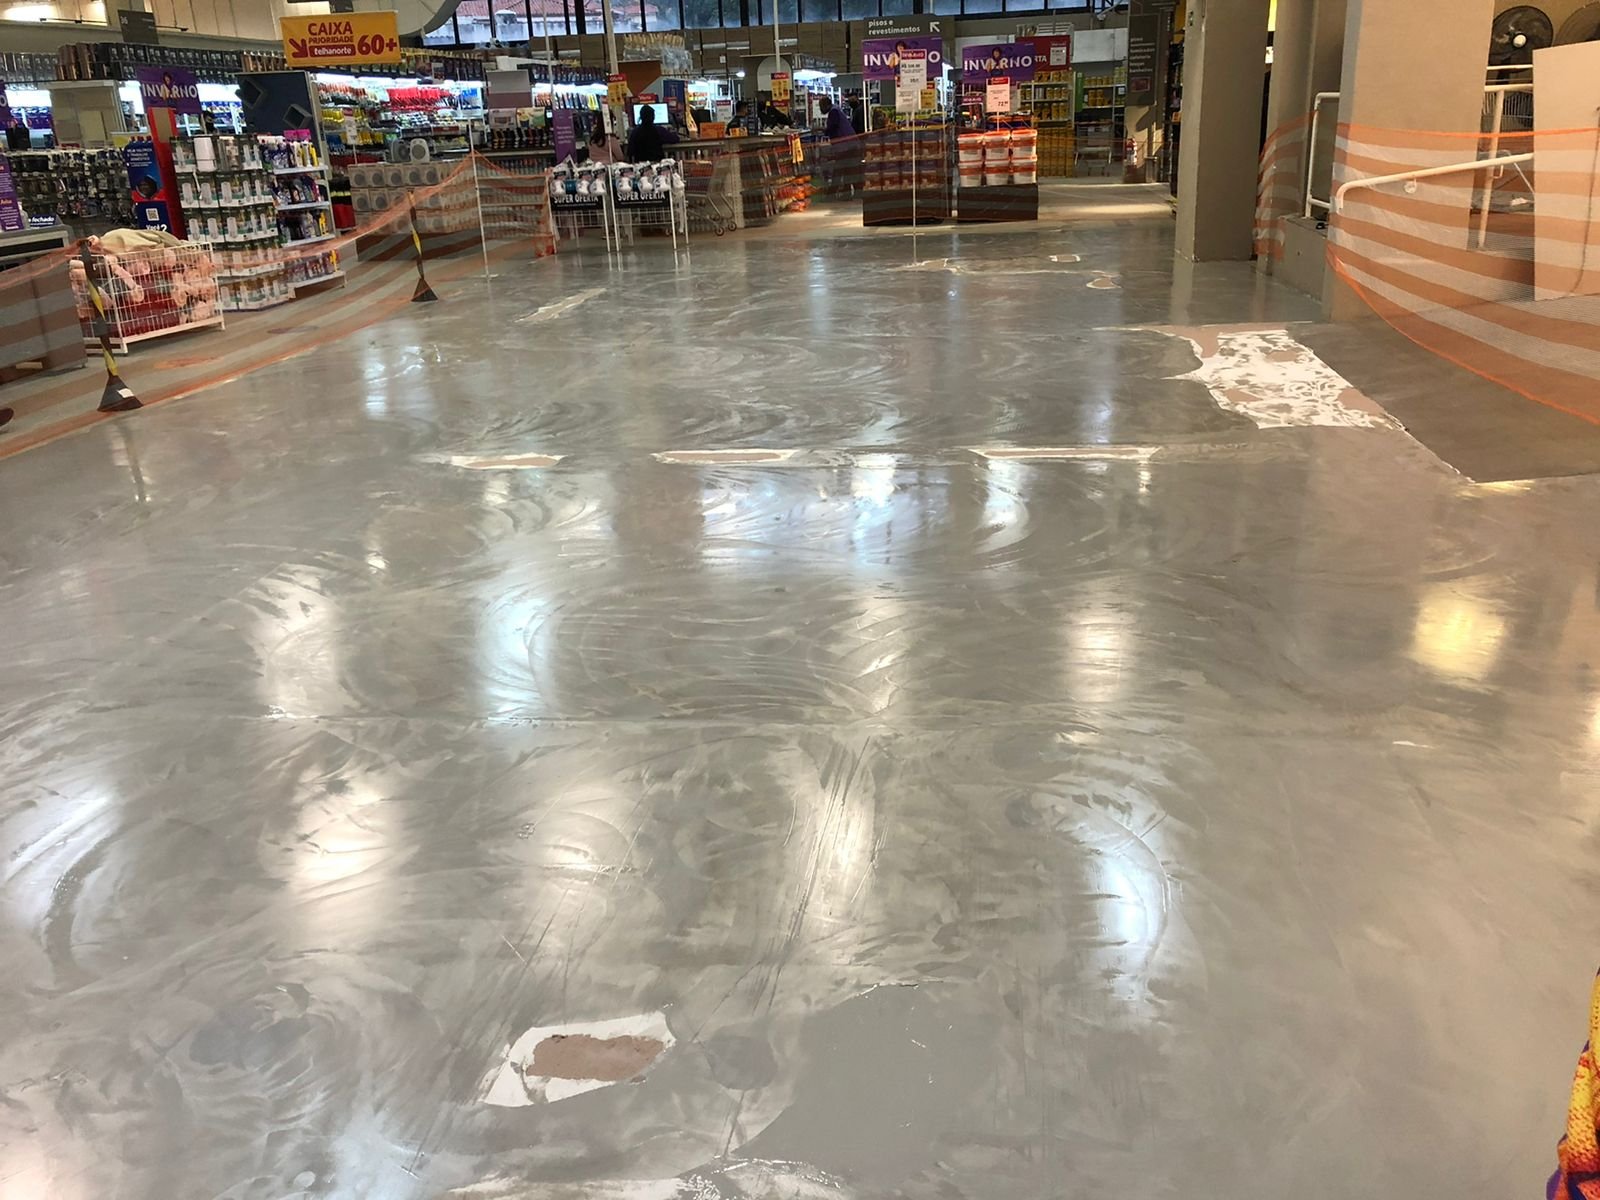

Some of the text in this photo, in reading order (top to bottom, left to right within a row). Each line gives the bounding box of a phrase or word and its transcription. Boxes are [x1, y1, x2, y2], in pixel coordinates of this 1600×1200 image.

[307, 21, 354, 36] CAIXA
[868, 19, 888, 28] pisos
[868, 26, 921, 35] revestimentos
[308, 35, 355, 45] PRIORIDADE
[357, 33, 398, 56] 60+
[314, 46, 352, 56] telhanorte
[963, 55, 1032, 71] INVRNO
[142, 82, 198, 99] INVRNO
